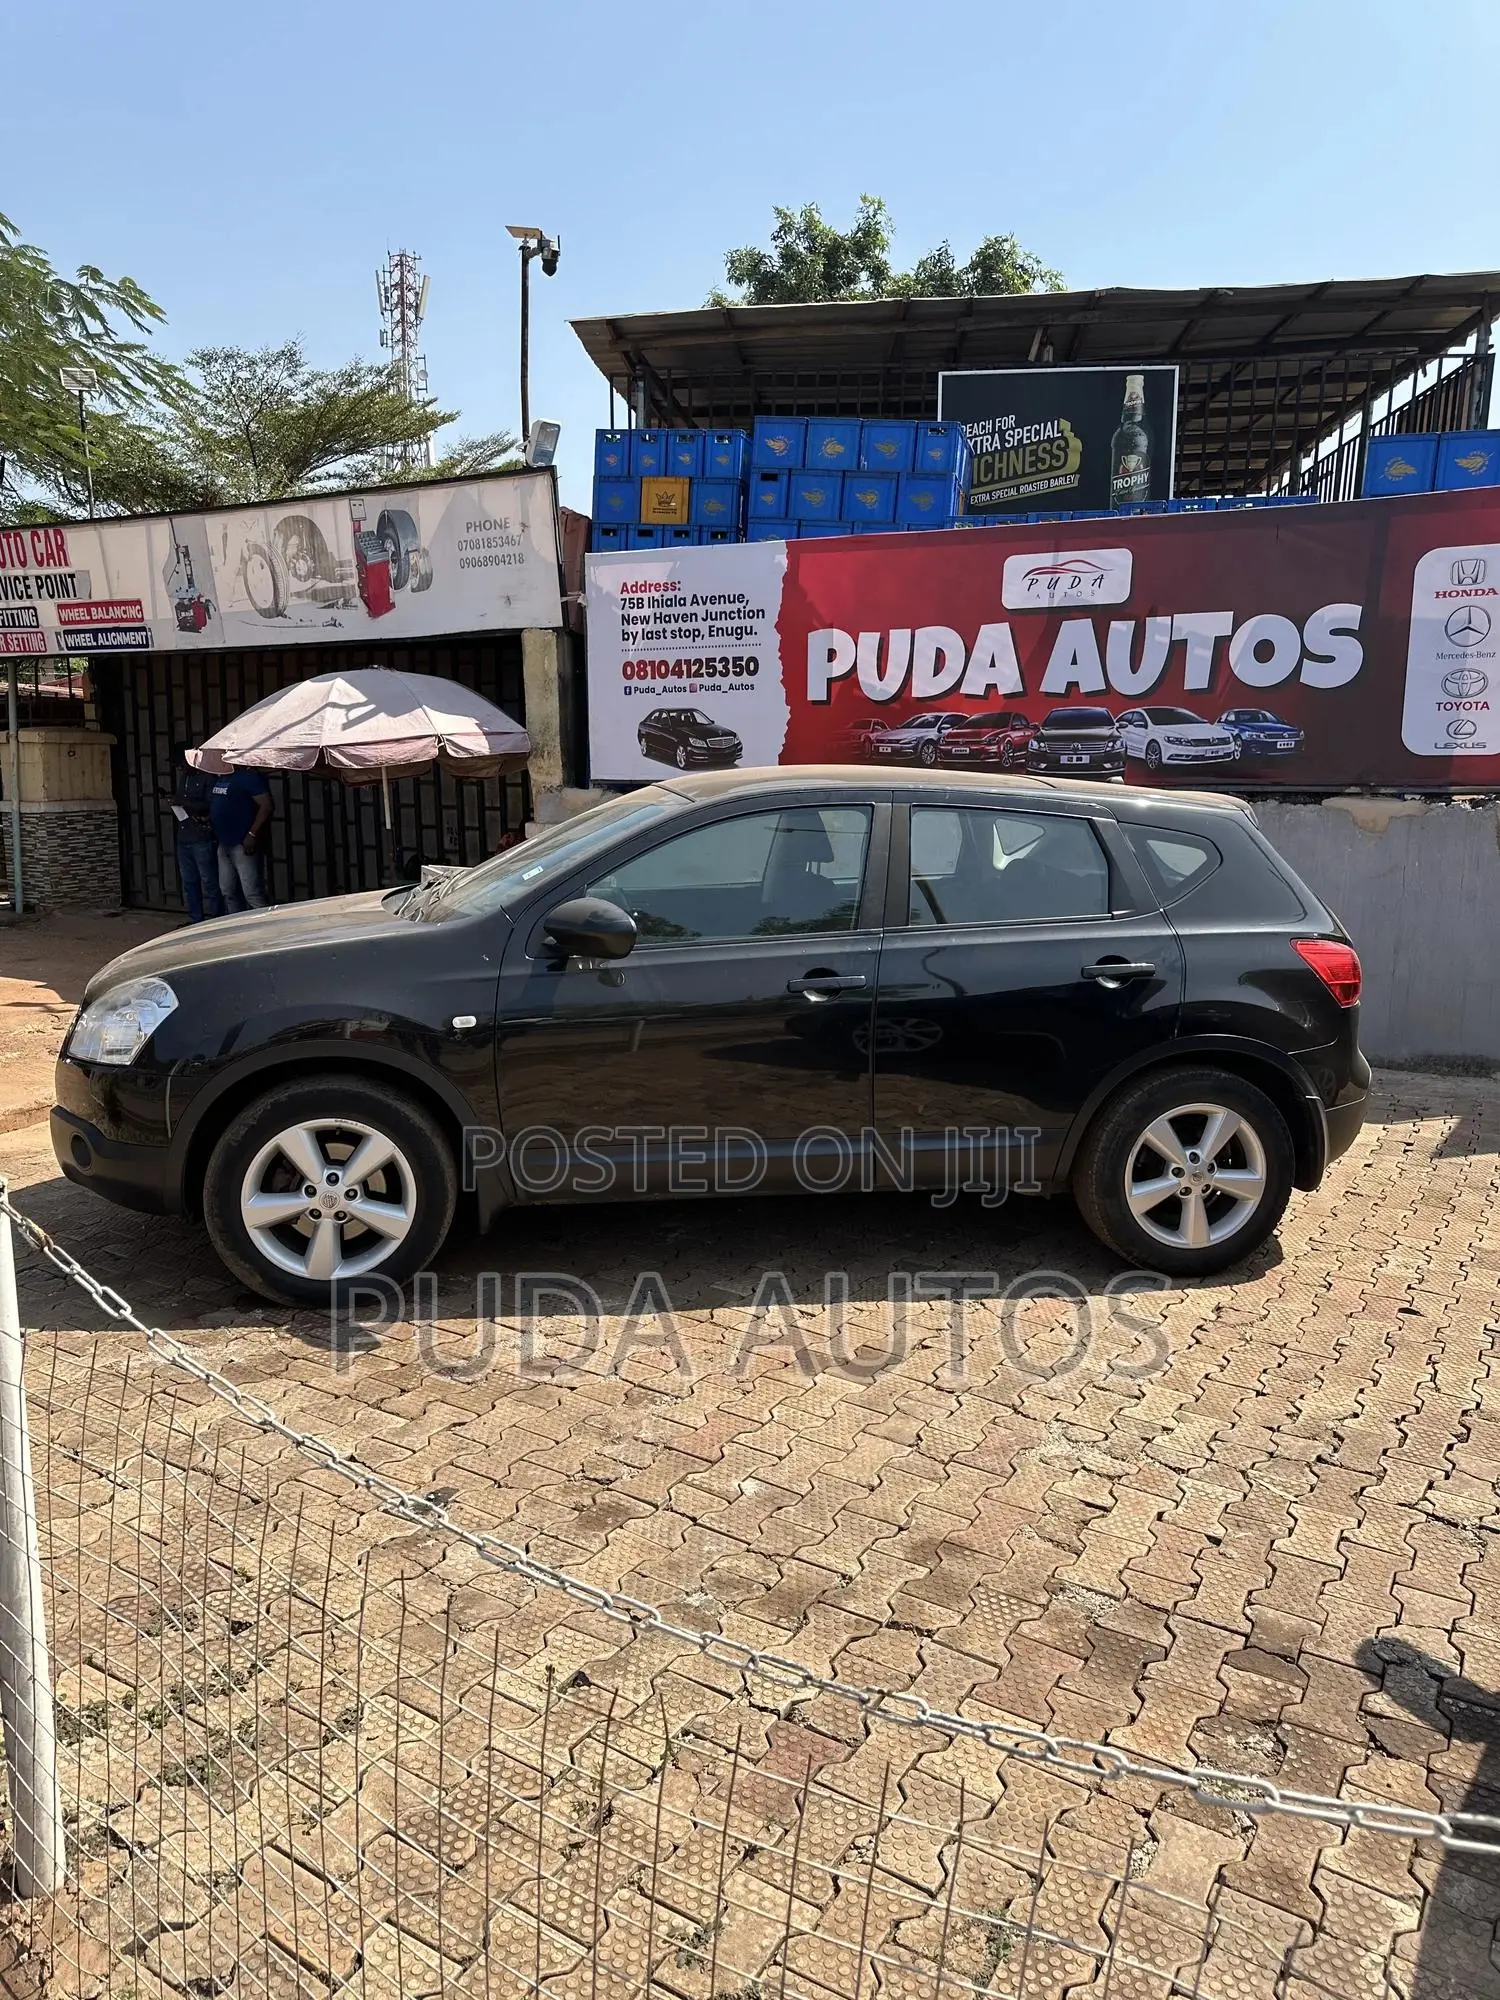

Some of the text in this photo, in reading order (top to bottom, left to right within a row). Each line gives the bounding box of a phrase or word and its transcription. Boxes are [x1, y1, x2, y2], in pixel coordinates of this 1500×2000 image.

[995, 414, 1016, 432] FOR
[966, 420, 1062, 456] XTRA SPECIAL
[972, 439, 1066, 485] ICHNESS
[970, 474, 1075, 505] EXTRA SPECIAL ROASTED BARLEY
[1112, 471, 1150, 491] TROPHY
[466, 517, 511, 533] PHONE
[30, 528, 69, 568] CAR
[457, 535, 521, 552] 07081853467
[459, 553, 525, 569] 09068904218
[0, 573, 78, 601] VICE POINT
[620, 580, 682, 595] Address:
[1027, 573, 1105, 592] PUDA
[620, 593, 750, 610] 75B Ihiala Avenue,
[1036, 590, 1096, 600] AUTOS
[1434, 587, 1499, 599] HONDA
[58, 605, 143, 622] WHEEL BALANCING
[621, 606, 766, 626] New Haven Junction
[7, 633, 46, 651] SETTING
[65, 633, 98, 648] WHEEL
[98, 631, 147, 646] ALIGNMENT
[621, 625, 758, 645] by last stop, Enugu.
[807, 603, 1364, 704] PUDA AUTOS
[1435, 651, 1497, 661] Mercedes-Benz
[622, 656, 760, 681] 08104125350
[633, 682, 755, 696] Puda_Autos Puda_Autos
[1435, 701, 1490, 712] TOYOTA
[1434, 741, 1487, 750] LEXUS
